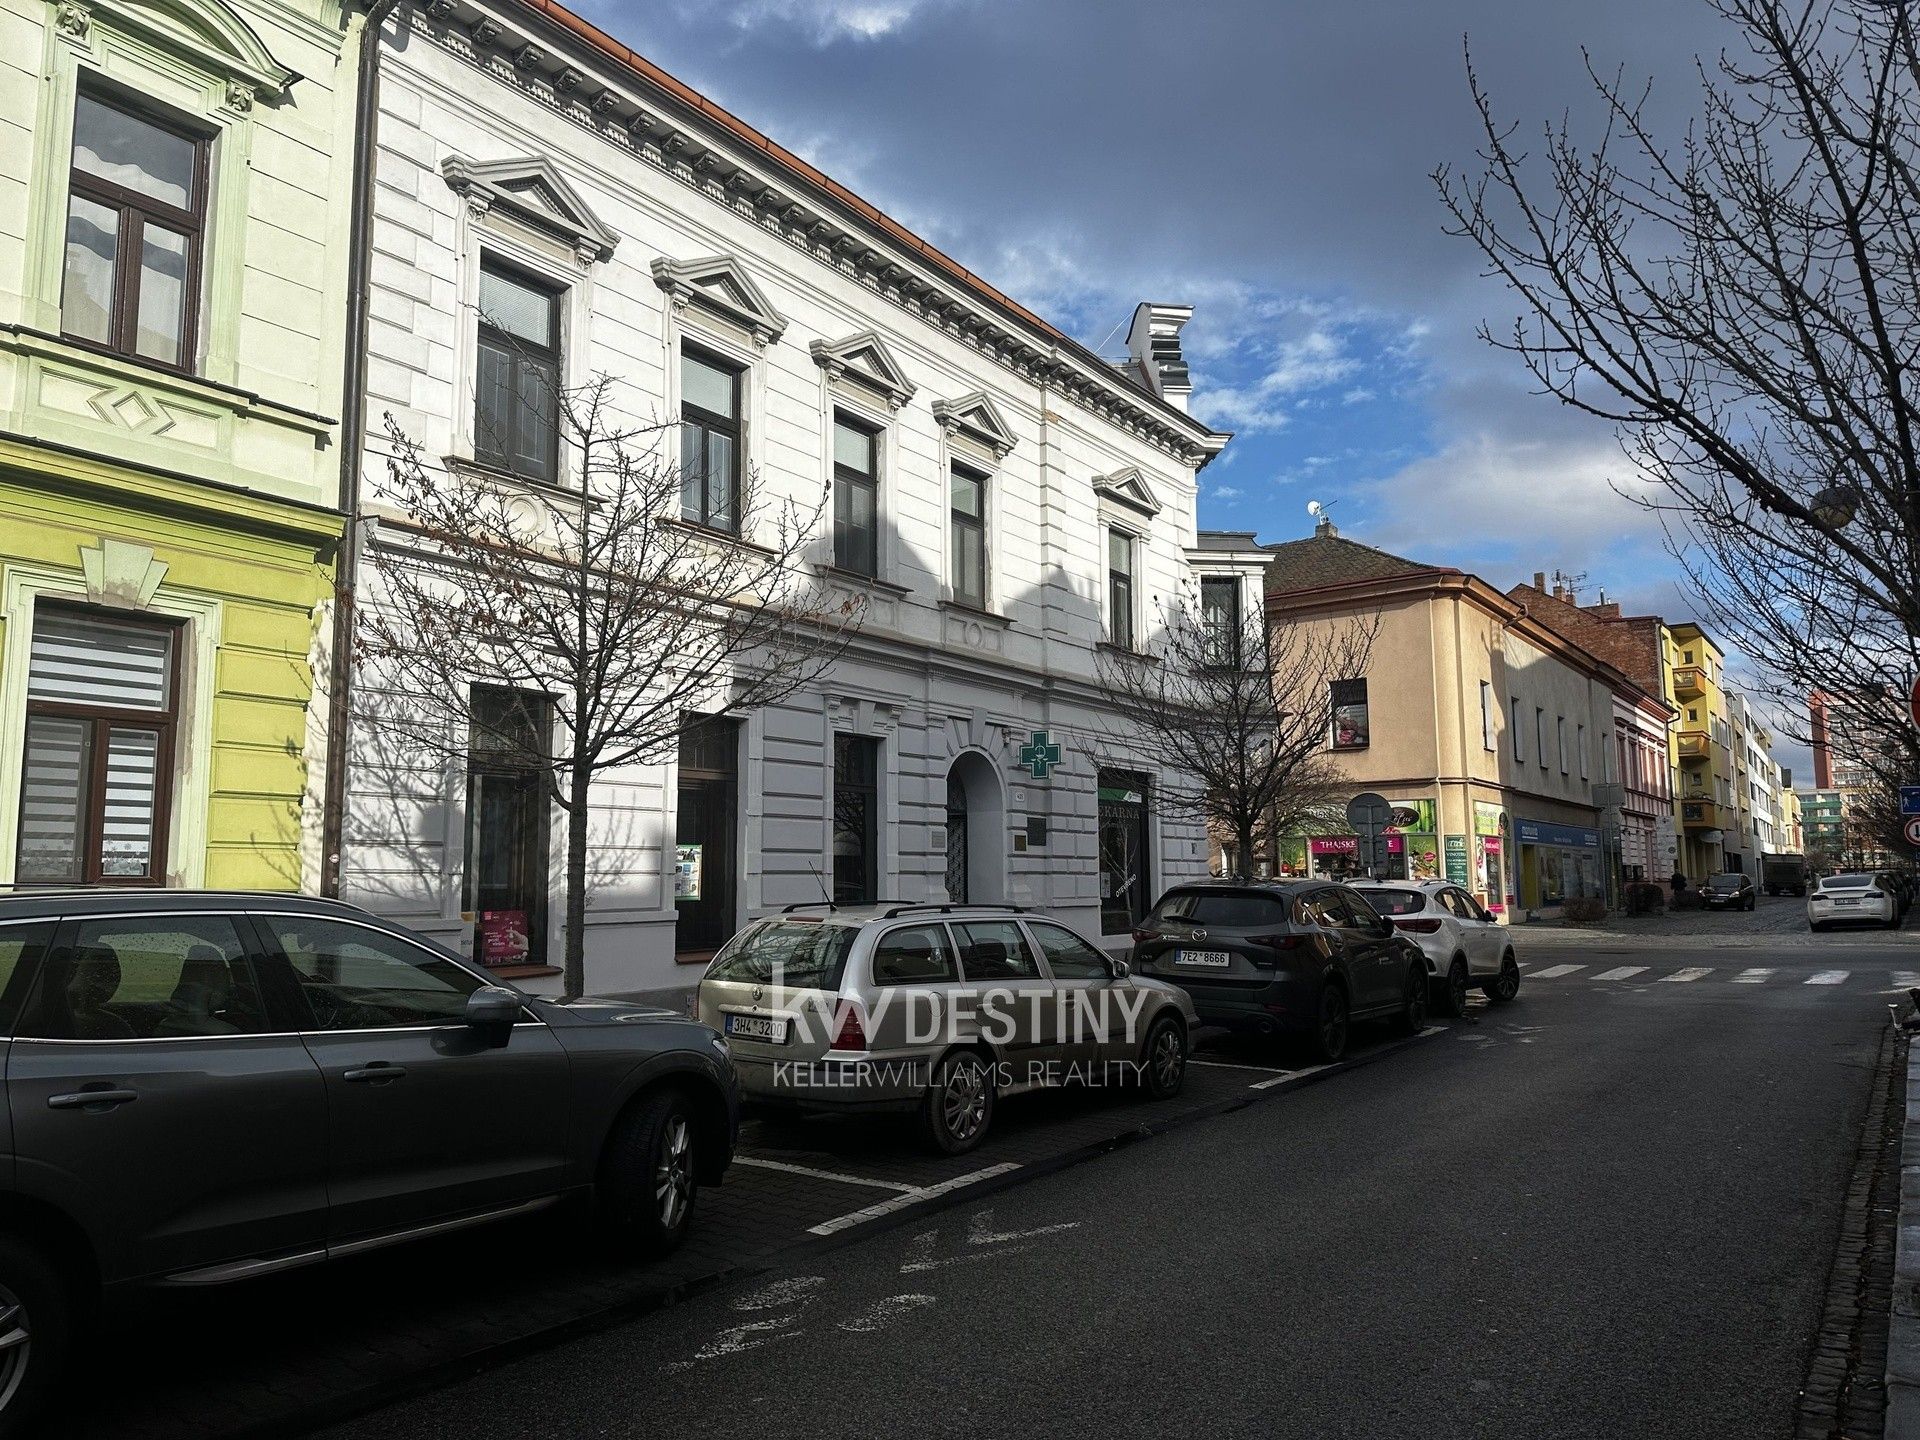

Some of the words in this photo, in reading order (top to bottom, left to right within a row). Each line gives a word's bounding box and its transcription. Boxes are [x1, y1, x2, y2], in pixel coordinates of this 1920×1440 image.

[1182, 951, 1198, 961] 7E2
[1204, 952, 1225, 963] 8666
[734, 1018, 751, 1033] 3H4
[760, 1021, 782, 1038] 3200
